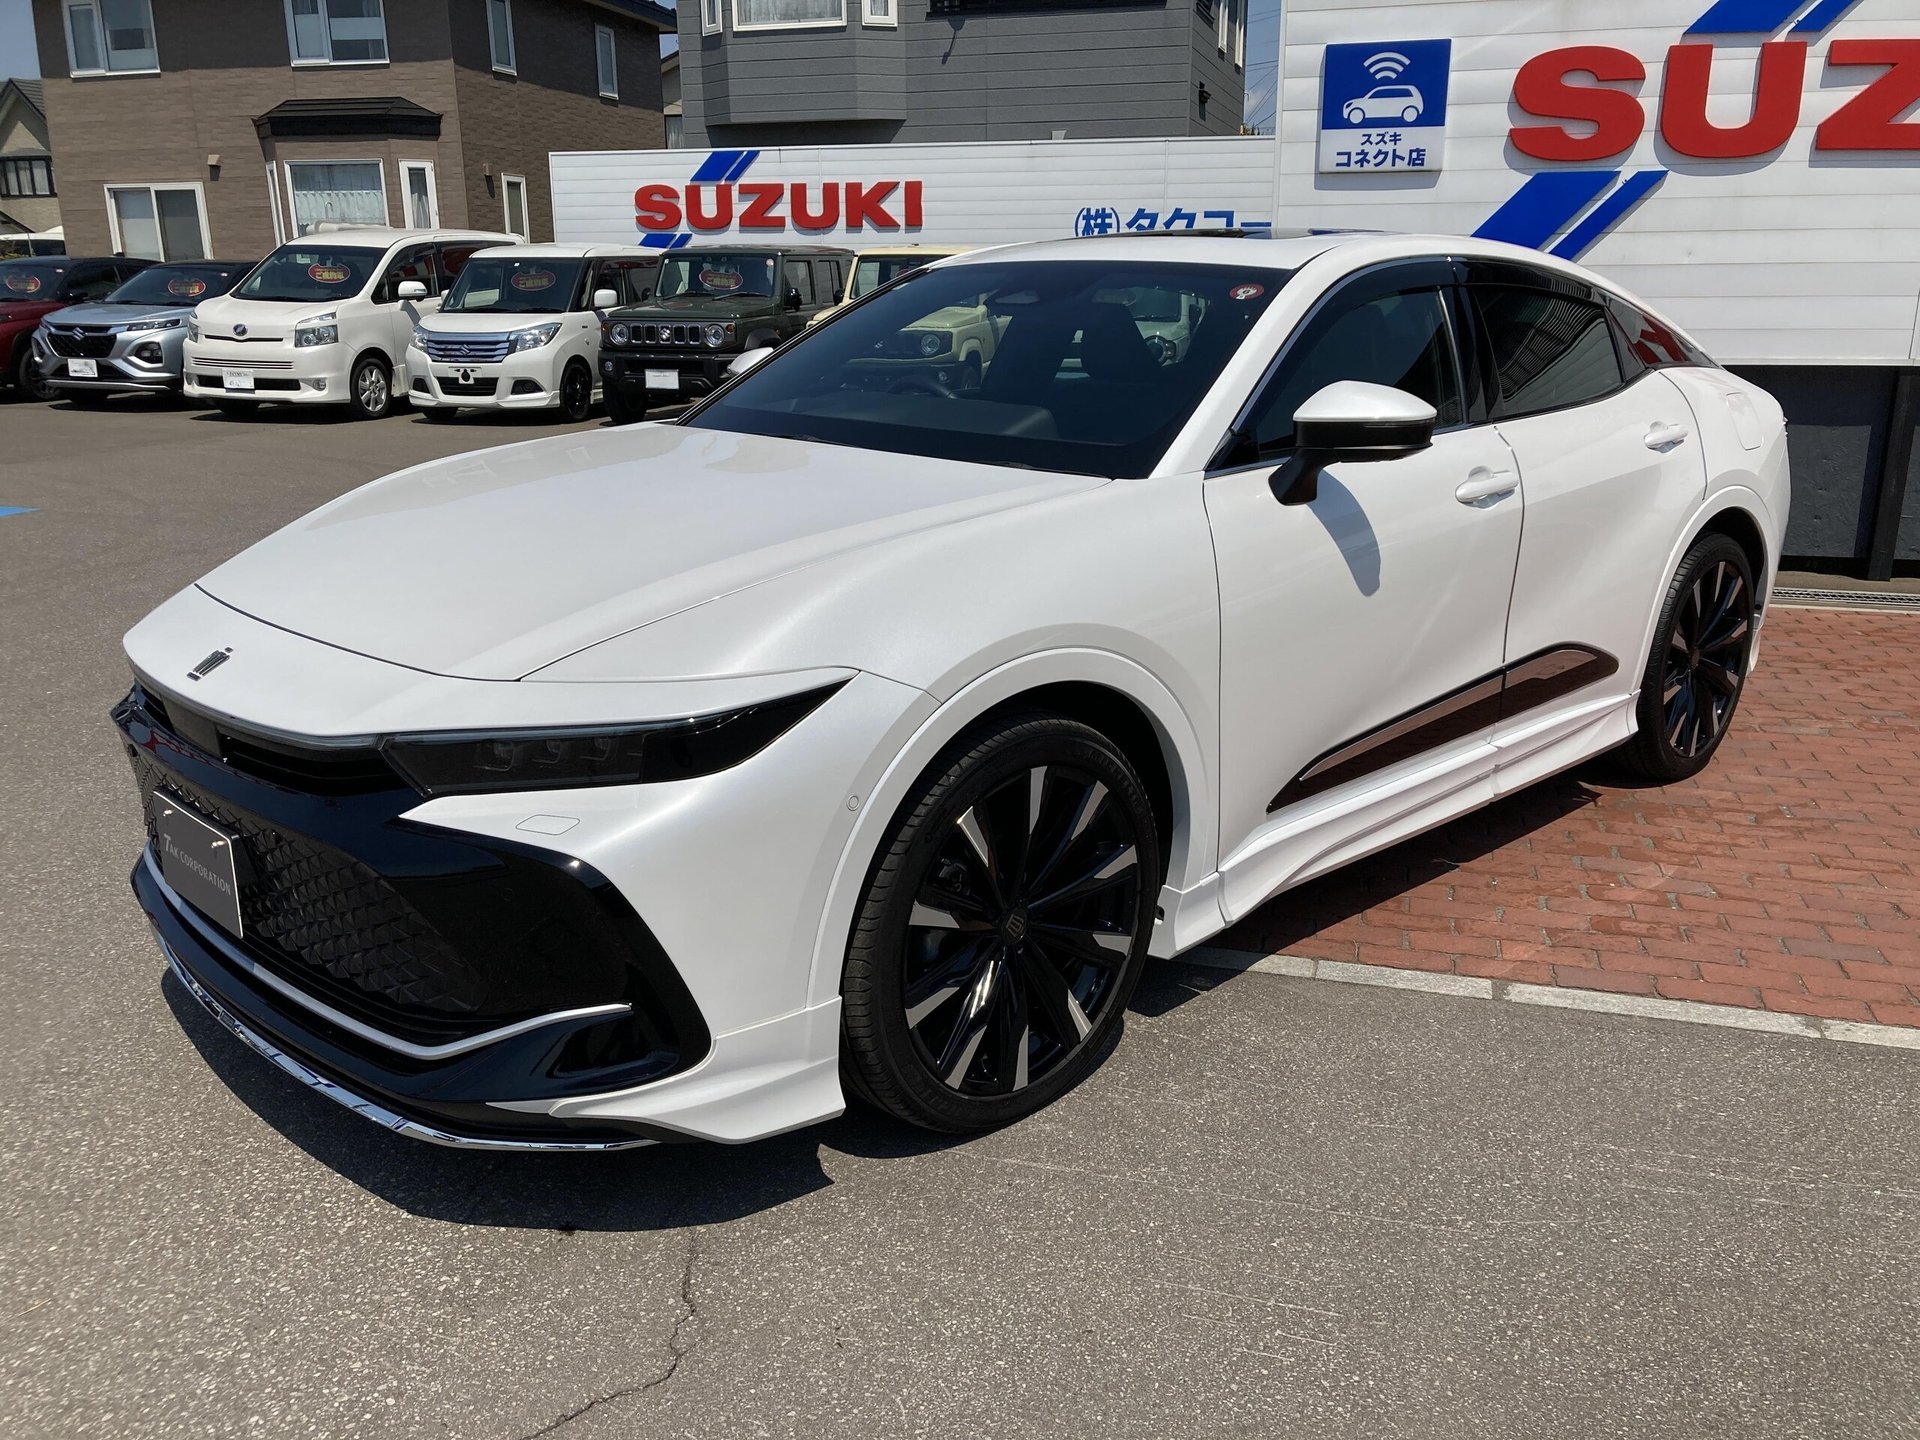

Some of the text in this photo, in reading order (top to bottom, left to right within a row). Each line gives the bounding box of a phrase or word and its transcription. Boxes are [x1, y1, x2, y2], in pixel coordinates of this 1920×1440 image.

[1509, 39, 1920, 161] SUZ
[1335, 147, 1426, 168] コネクト店
[1360, 131, 1402, 146] スズキ
[634, 180, 923, 230] SUZUKI
[180, 850, 231, 896] CORPORATION
